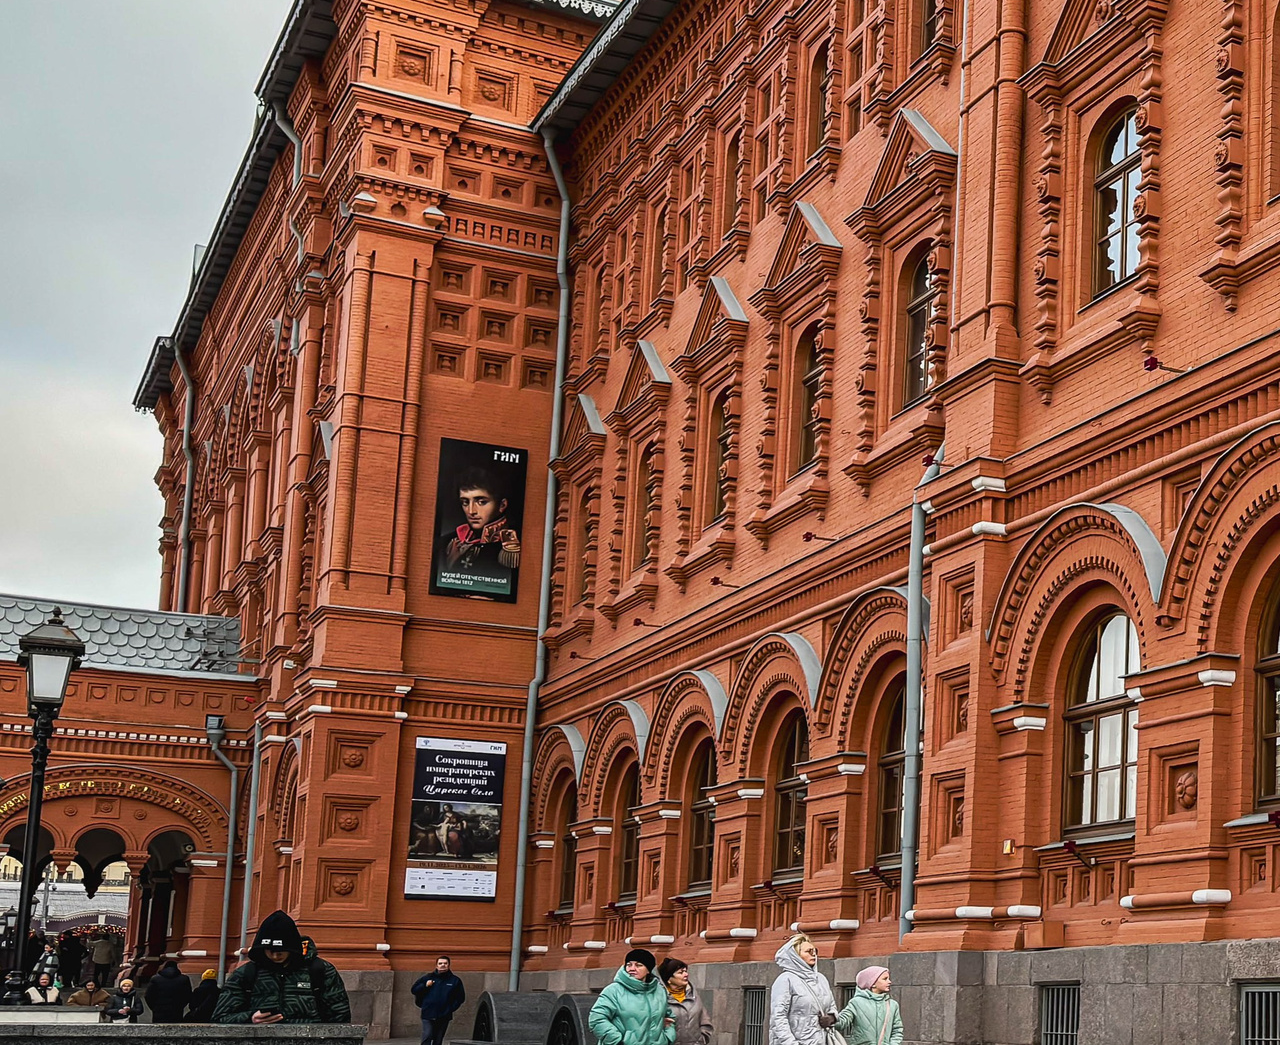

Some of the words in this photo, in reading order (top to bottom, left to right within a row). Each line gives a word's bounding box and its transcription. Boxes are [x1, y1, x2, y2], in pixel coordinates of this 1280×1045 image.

[494, 450, 519, 463] ГИМ
[461, 574, 507, 584] ОТЕЧЕСТВЕННОЙ
[435, 754, 488, 768] Сокровища
[425, 766, 496, 777] императорских
[433, 776, 488, 786] резиденций
[422, 784, 468, 795] Царское
[470, 787, 494, 797] Село
